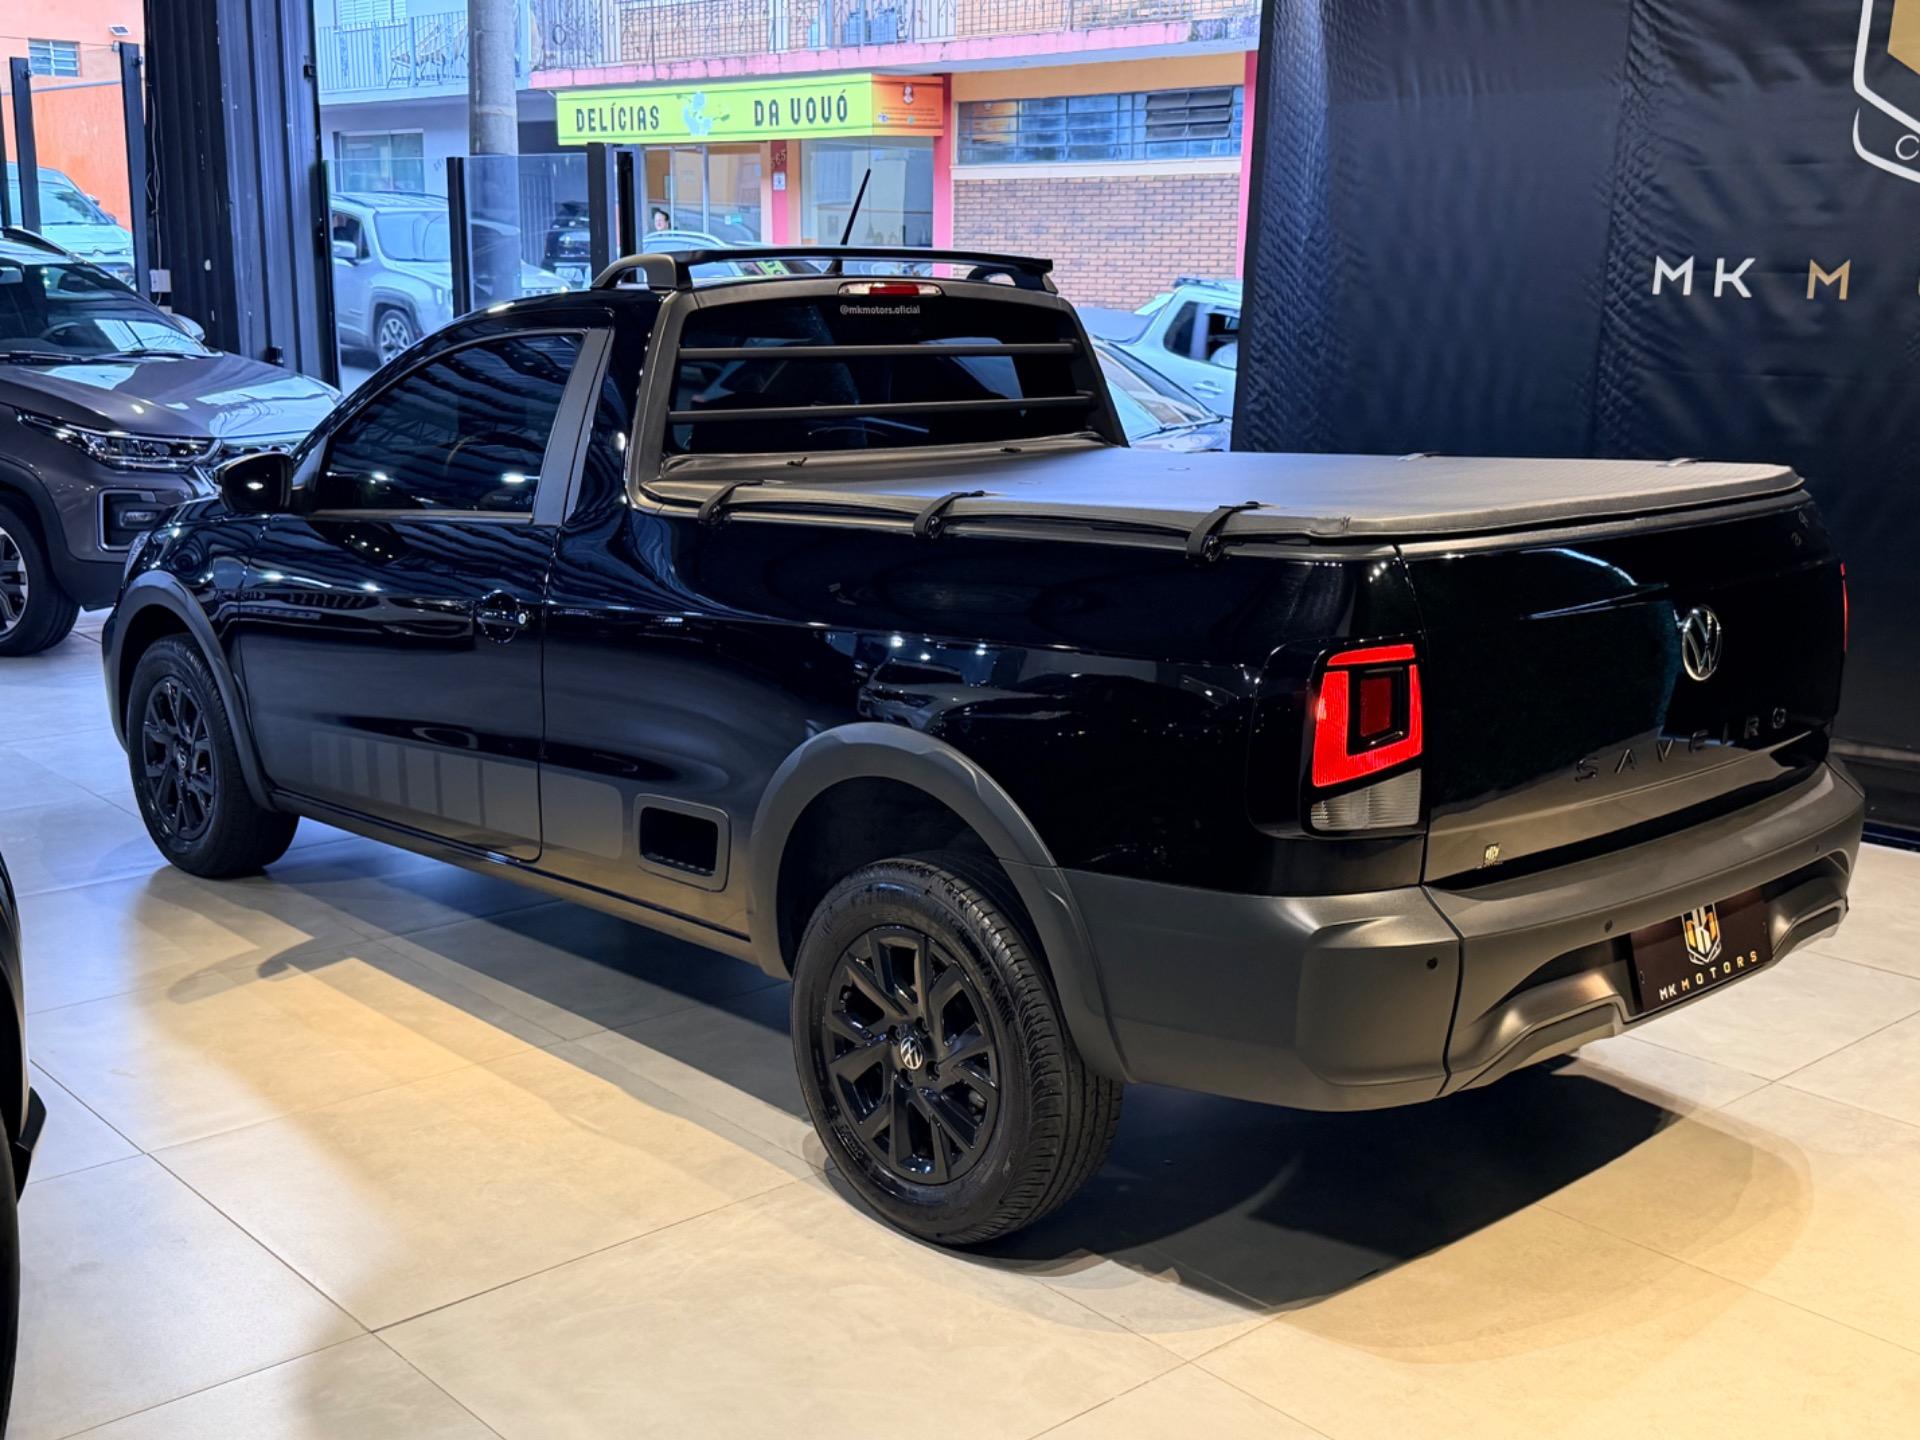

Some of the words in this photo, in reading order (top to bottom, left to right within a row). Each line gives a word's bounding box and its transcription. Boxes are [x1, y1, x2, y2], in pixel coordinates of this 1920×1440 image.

[576, 102, 660, 133] DELÍCIAS
[754, 99, 779, 126] DA
[1652, 255, 1756, 298] MK
[840, 304, 920, 316] @mkmotors.oficial
[1574, 707, 1786, 782] SAVEIRO
[1658, 983, 1678, 1001] MK
[1681, 950, 1758, 992] MOTORS
